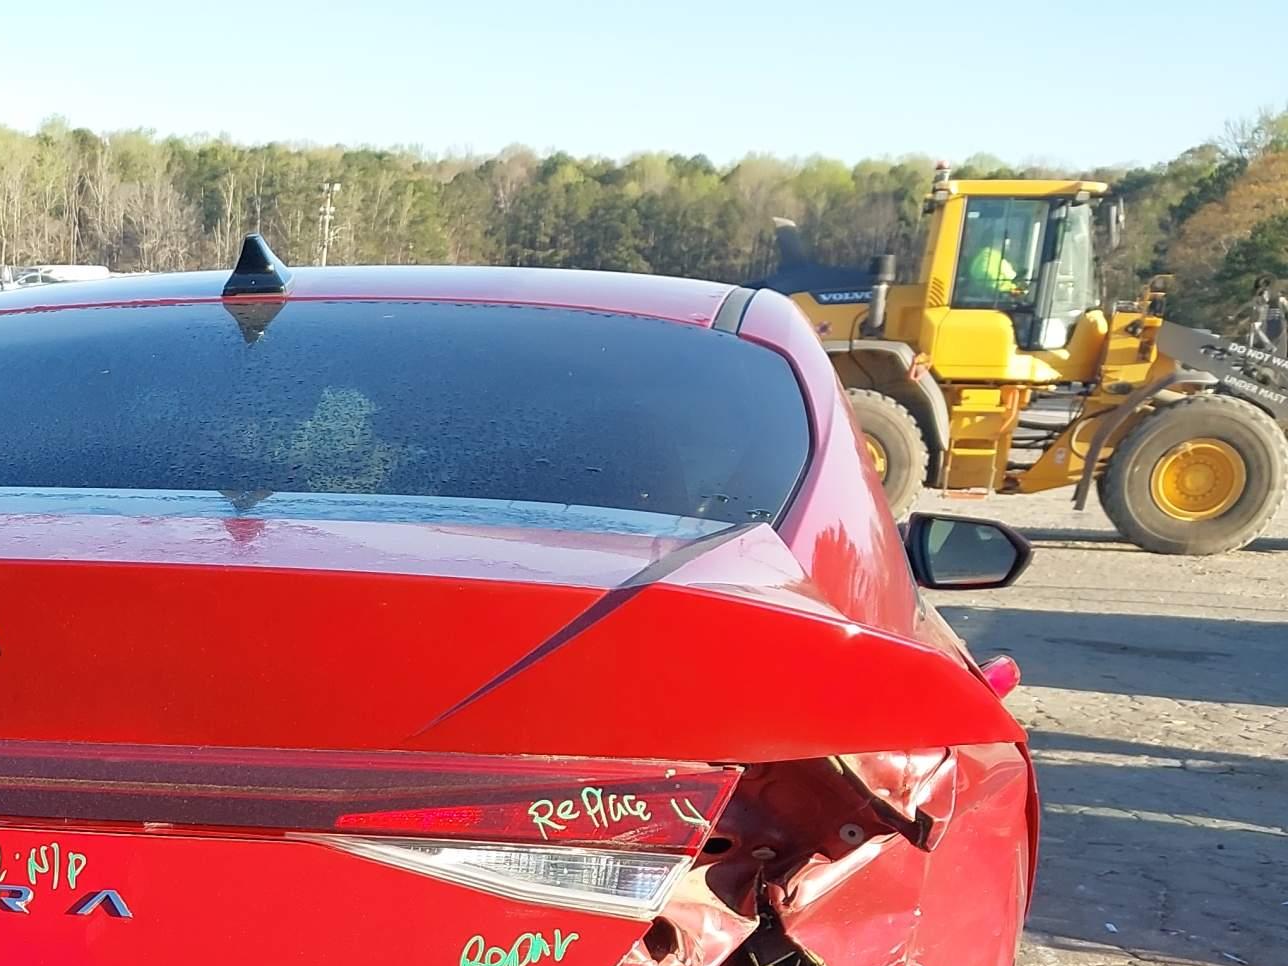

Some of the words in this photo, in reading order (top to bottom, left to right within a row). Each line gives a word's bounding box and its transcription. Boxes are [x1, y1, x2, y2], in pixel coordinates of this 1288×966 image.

[1228, 342, 1247, 353] DO
[1246, 348, 1272, 363] NOT
[1223, 374, 1258, 393] UNDER
[1258, 388, 1288, 404] MAST
